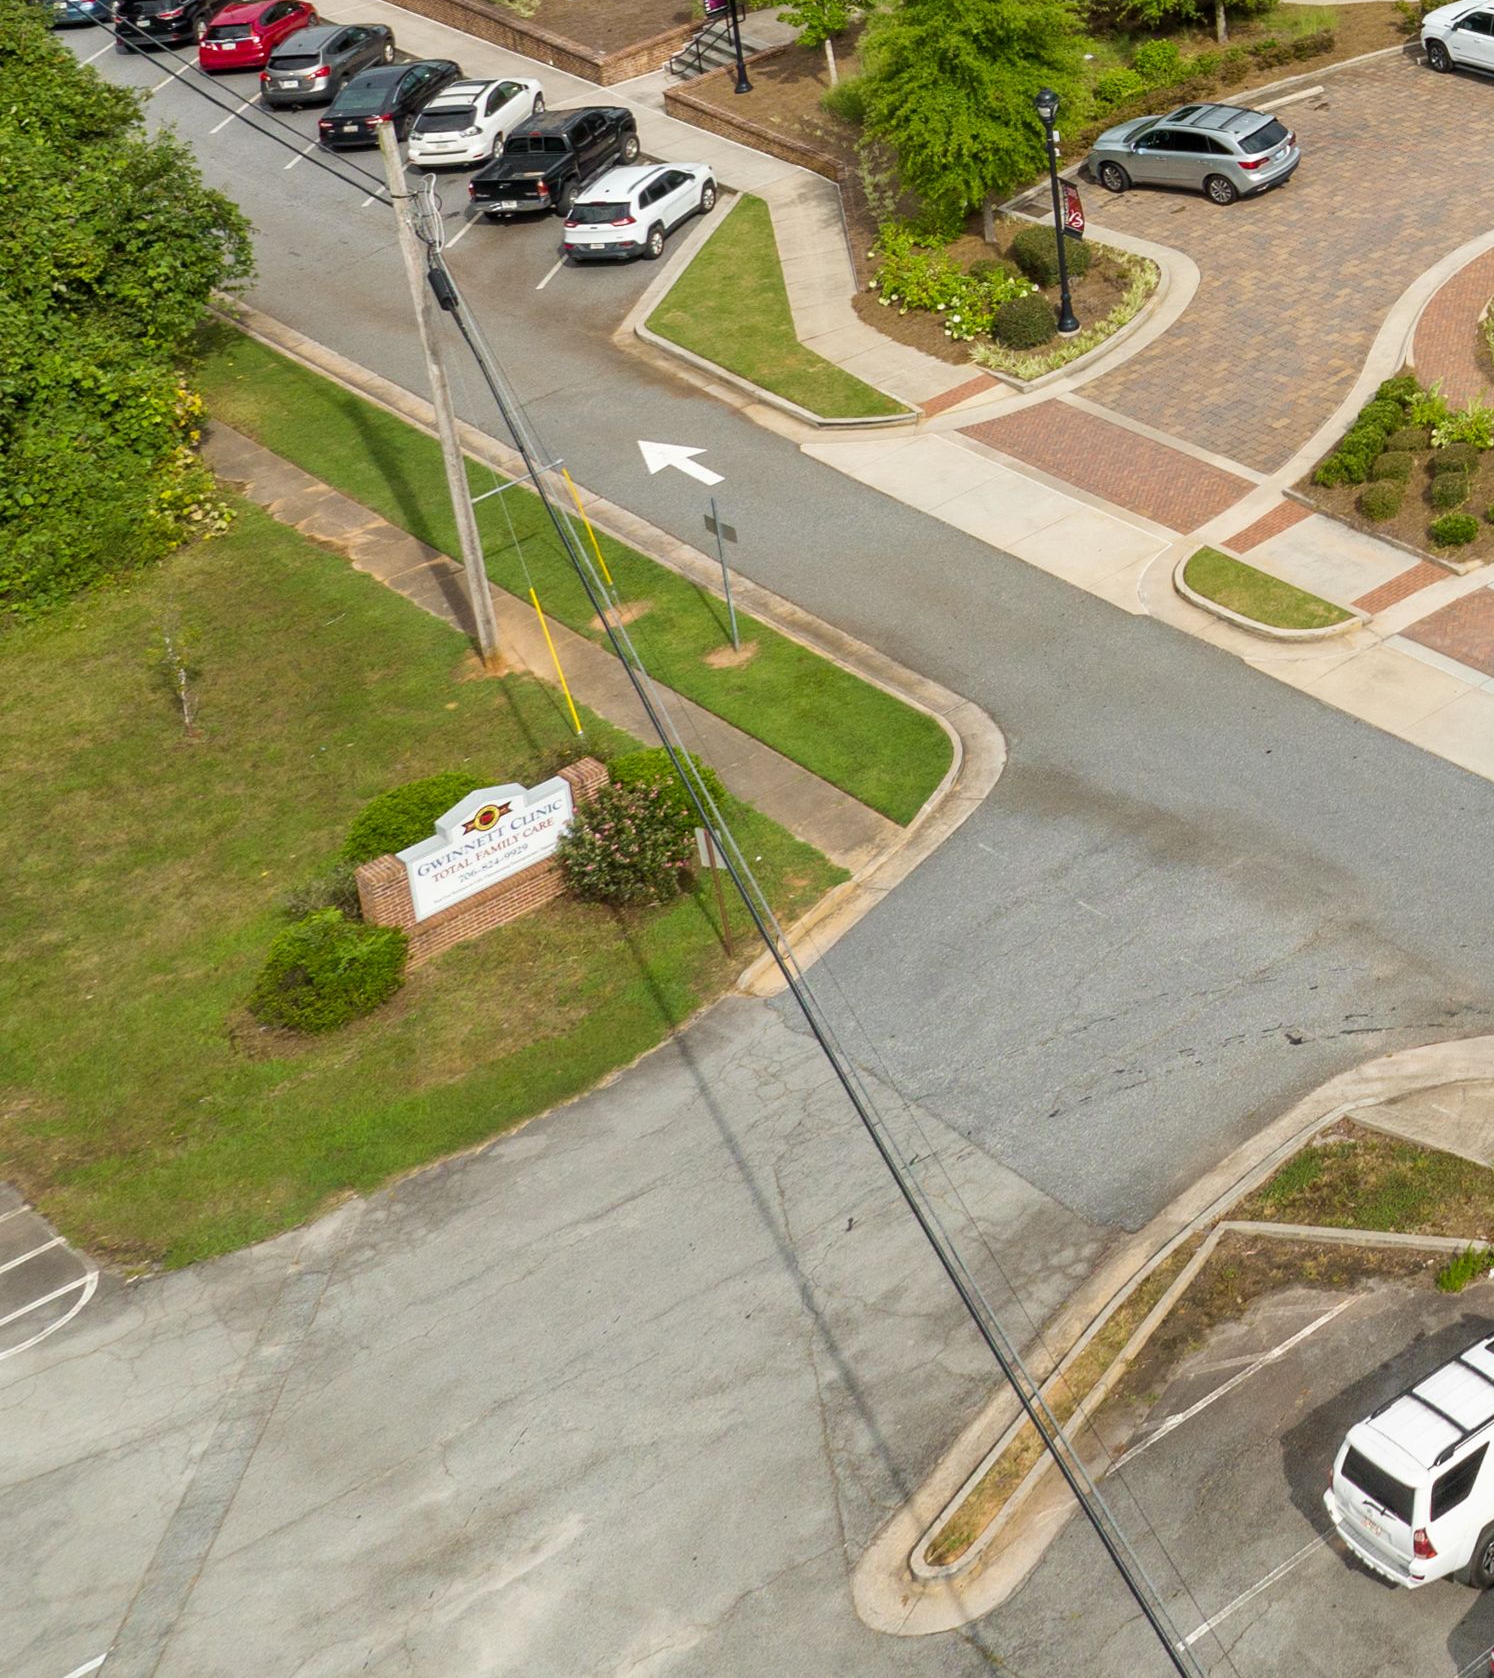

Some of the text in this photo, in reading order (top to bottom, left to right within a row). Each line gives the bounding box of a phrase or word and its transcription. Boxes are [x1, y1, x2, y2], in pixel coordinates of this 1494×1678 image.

[417, 825, 507, 877] GWINNETT
[510, 799, 563, 830] CLINIC
[432, 817, 554, 883] TOTAL FAMILY CARE
